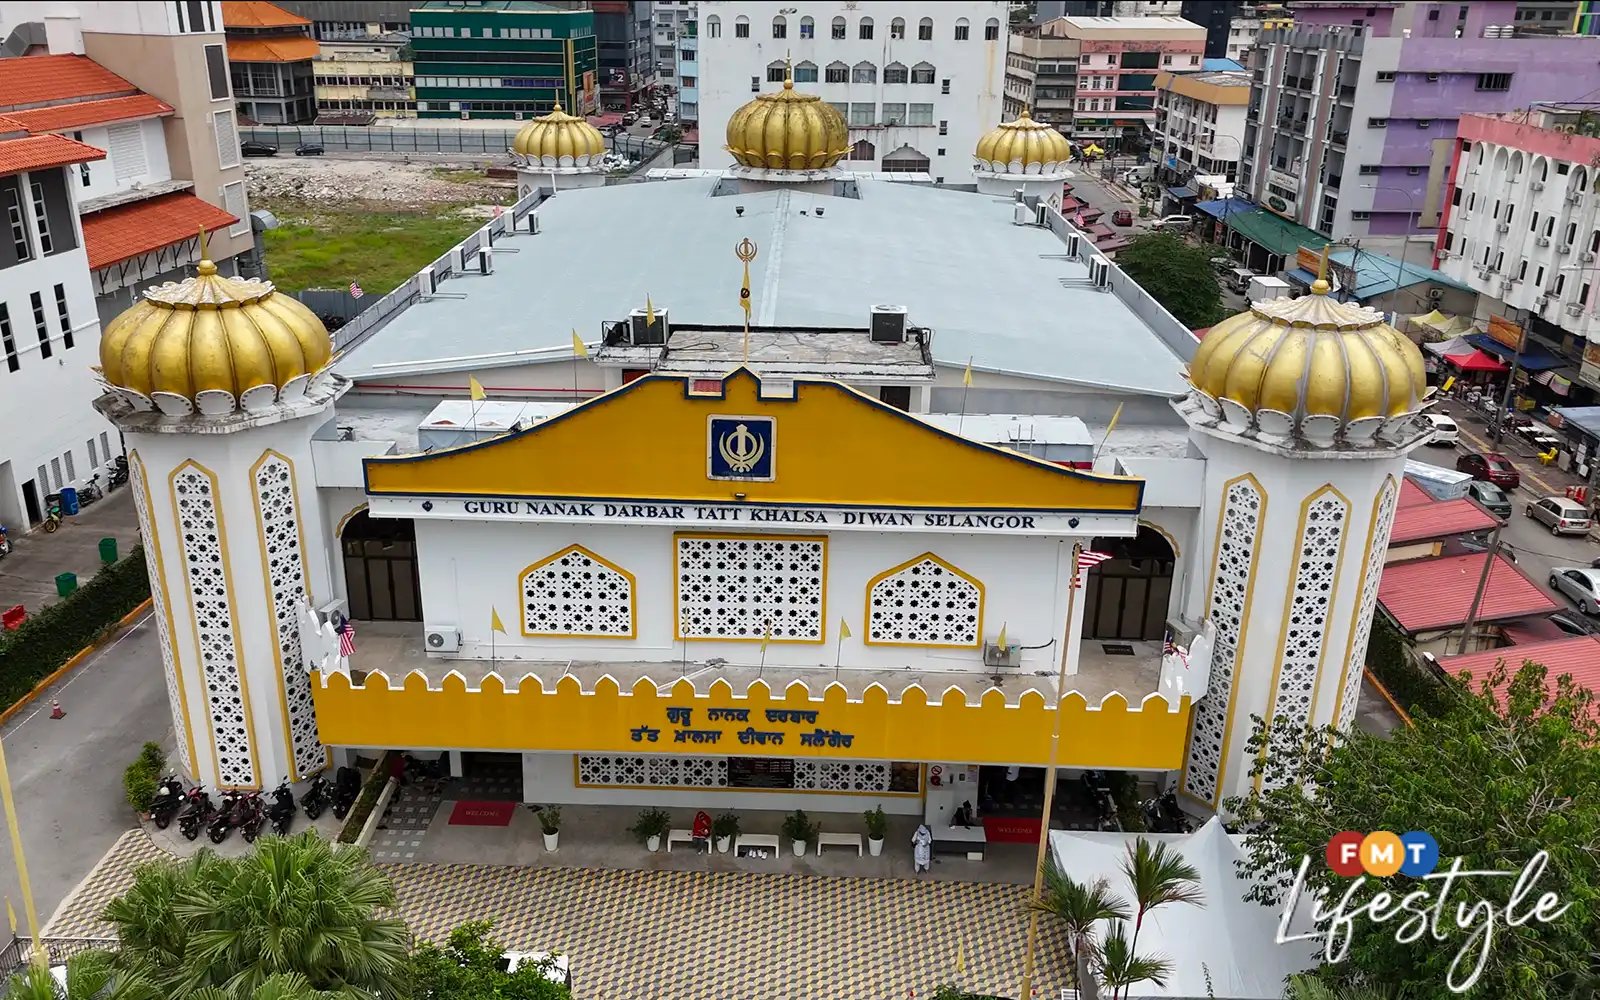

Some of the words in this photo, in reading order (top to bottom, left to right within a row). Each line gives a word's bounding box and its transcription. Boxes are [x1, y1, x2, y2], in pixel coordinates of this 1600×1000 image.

[464, 500, 519, 514] GURU
[525, 502, 595, 517] NANAK
[604, 504, 686, 519] DARBAR
[693, 507, 741, 521] TATT
[750, 508, 828, 524] KHALSA
[844, 511, 914, 526] DIWAN
[924, 513, 1035, 529] SELANGOR
[666, 707, 693, 727] ਗੁਰੂ
[708, 708, 751, 723] ਨਾਨਕ
[766, 708, 819, 724] ਦਰਬਾਰ
